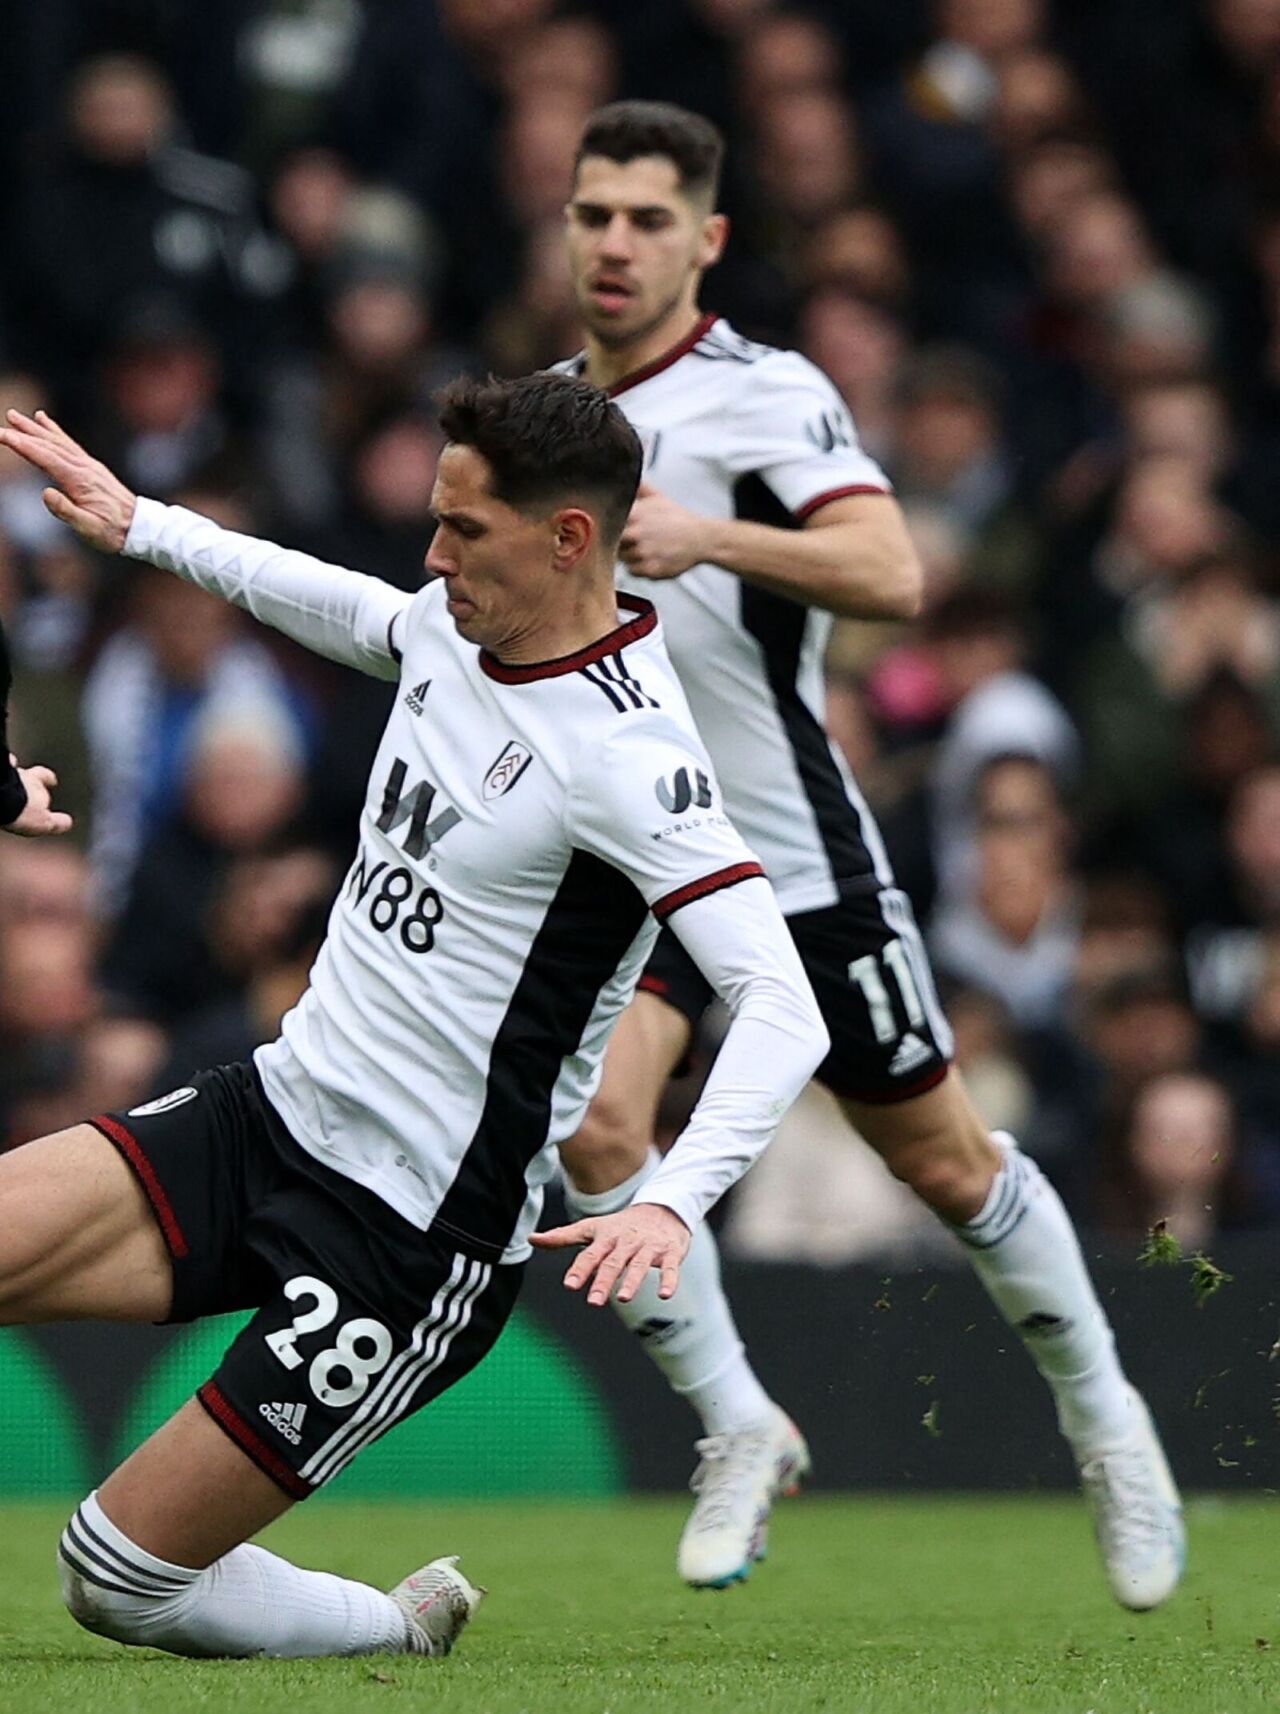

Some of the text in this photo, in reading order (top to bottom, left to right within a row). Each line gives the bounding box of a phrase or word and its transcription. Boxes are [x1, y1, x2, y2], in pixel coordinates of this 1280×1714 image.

[490, 753, 521, 789] FFC
[650, 819, 701, 841] WORLD
[847, 937, 925, 1044] 11
[264, 1275, 393, 1408] 28
[258, 1403, 302, 1446] adidas
